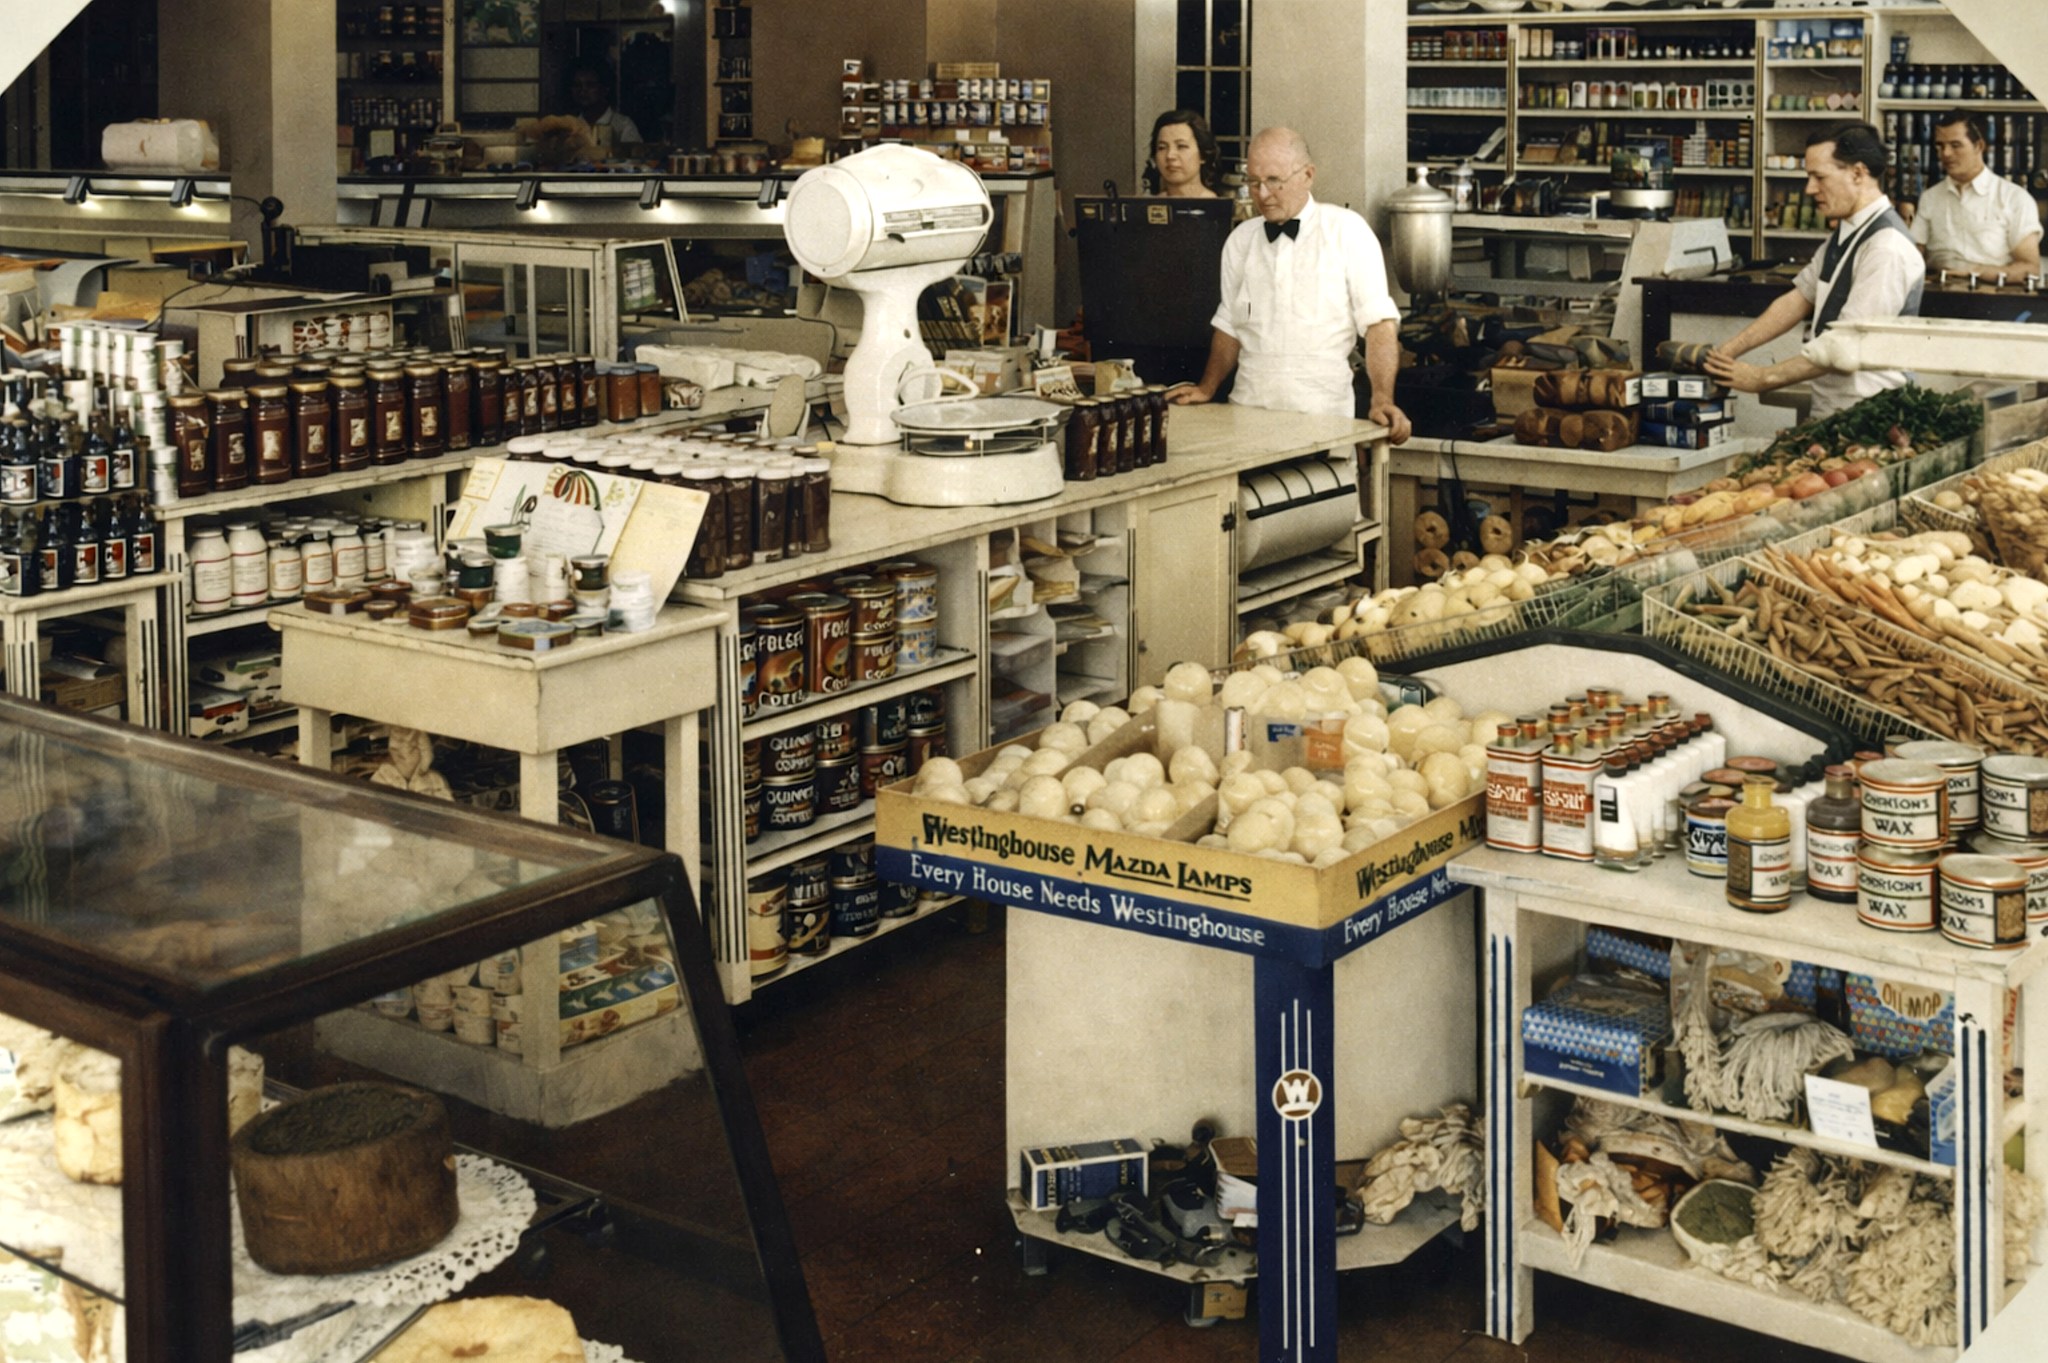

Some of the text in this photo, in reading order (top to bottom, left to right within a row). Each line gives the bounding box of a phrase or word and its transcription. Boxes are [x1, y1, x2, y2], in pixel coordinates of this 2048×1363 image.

[920, 812, 1077, 866] Westinghouse
[1871, 816, 1915, 837] WAX
[1356, 832, 1454, 900] Westinghouse
[910, 853, 1266, 947] Every House Needs Westinghouse
[1344, 887, 1429, 945] Every House
[1866, 898, 1908, 921] WAX
[1907, 990, 1943, 1020] MOP
